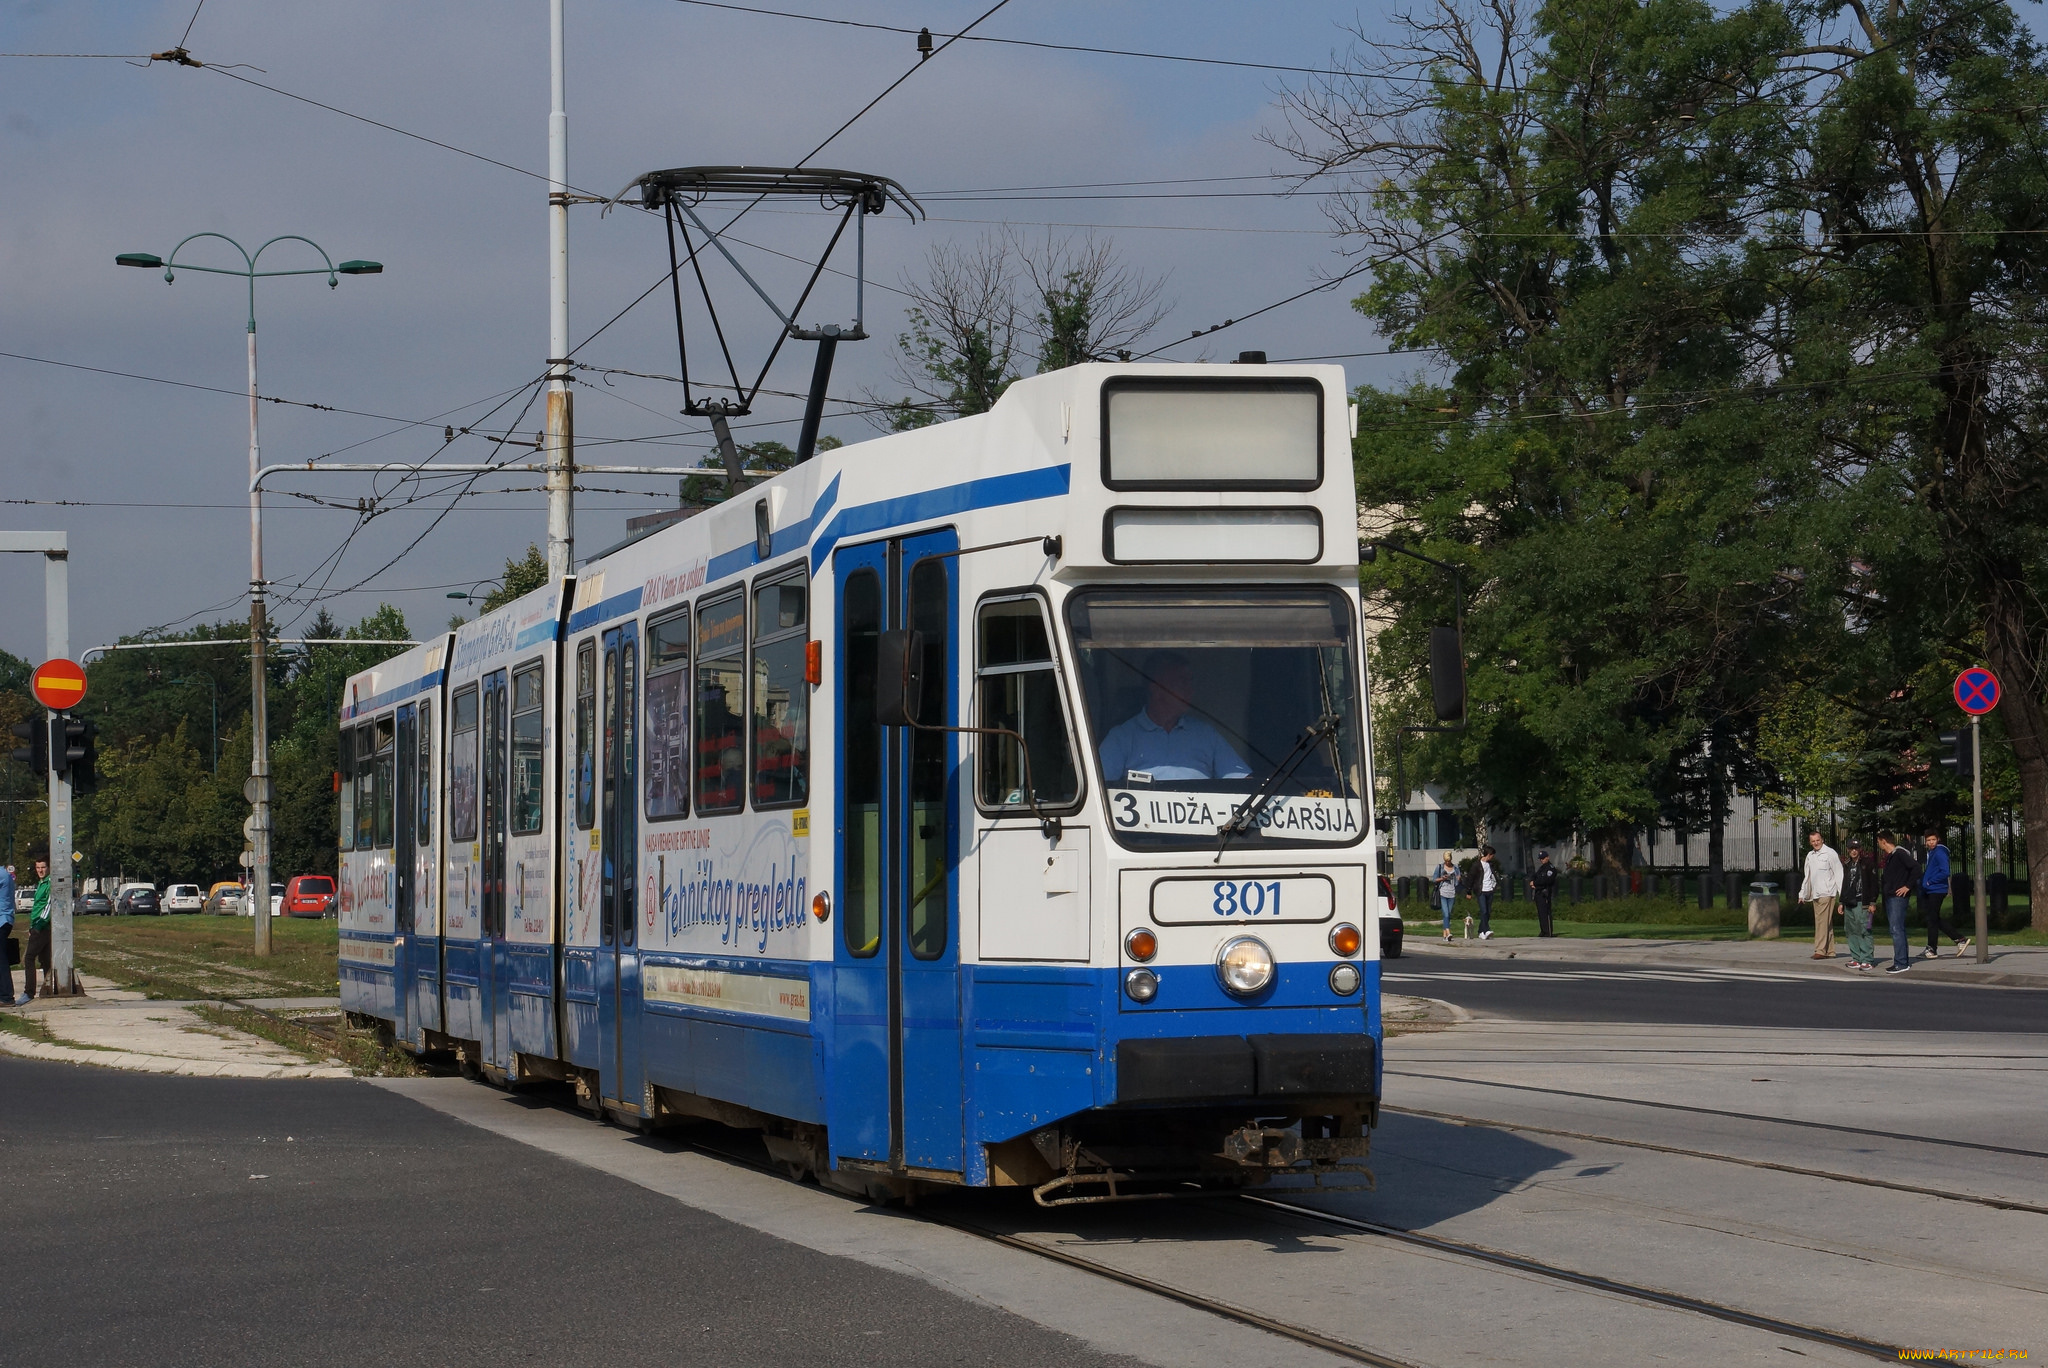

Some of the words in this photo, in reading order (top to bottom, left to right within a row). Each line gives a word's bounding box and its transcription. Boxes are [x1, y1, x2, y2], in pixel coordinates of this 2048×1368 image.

[643, 575, 661, 606] GRAS
[1114, 792, 1140, 828] 3
[680, 829, 697, 851] ISPITNE
[697, 828, 710, 852] LINIJE
[663, 859, 732, 946] Tehničkog
[734, 855, 806, 954] pregleda
[1213, 881, 1281, 916] 801
[779, 989, 805, 1010] www.gras.ba
